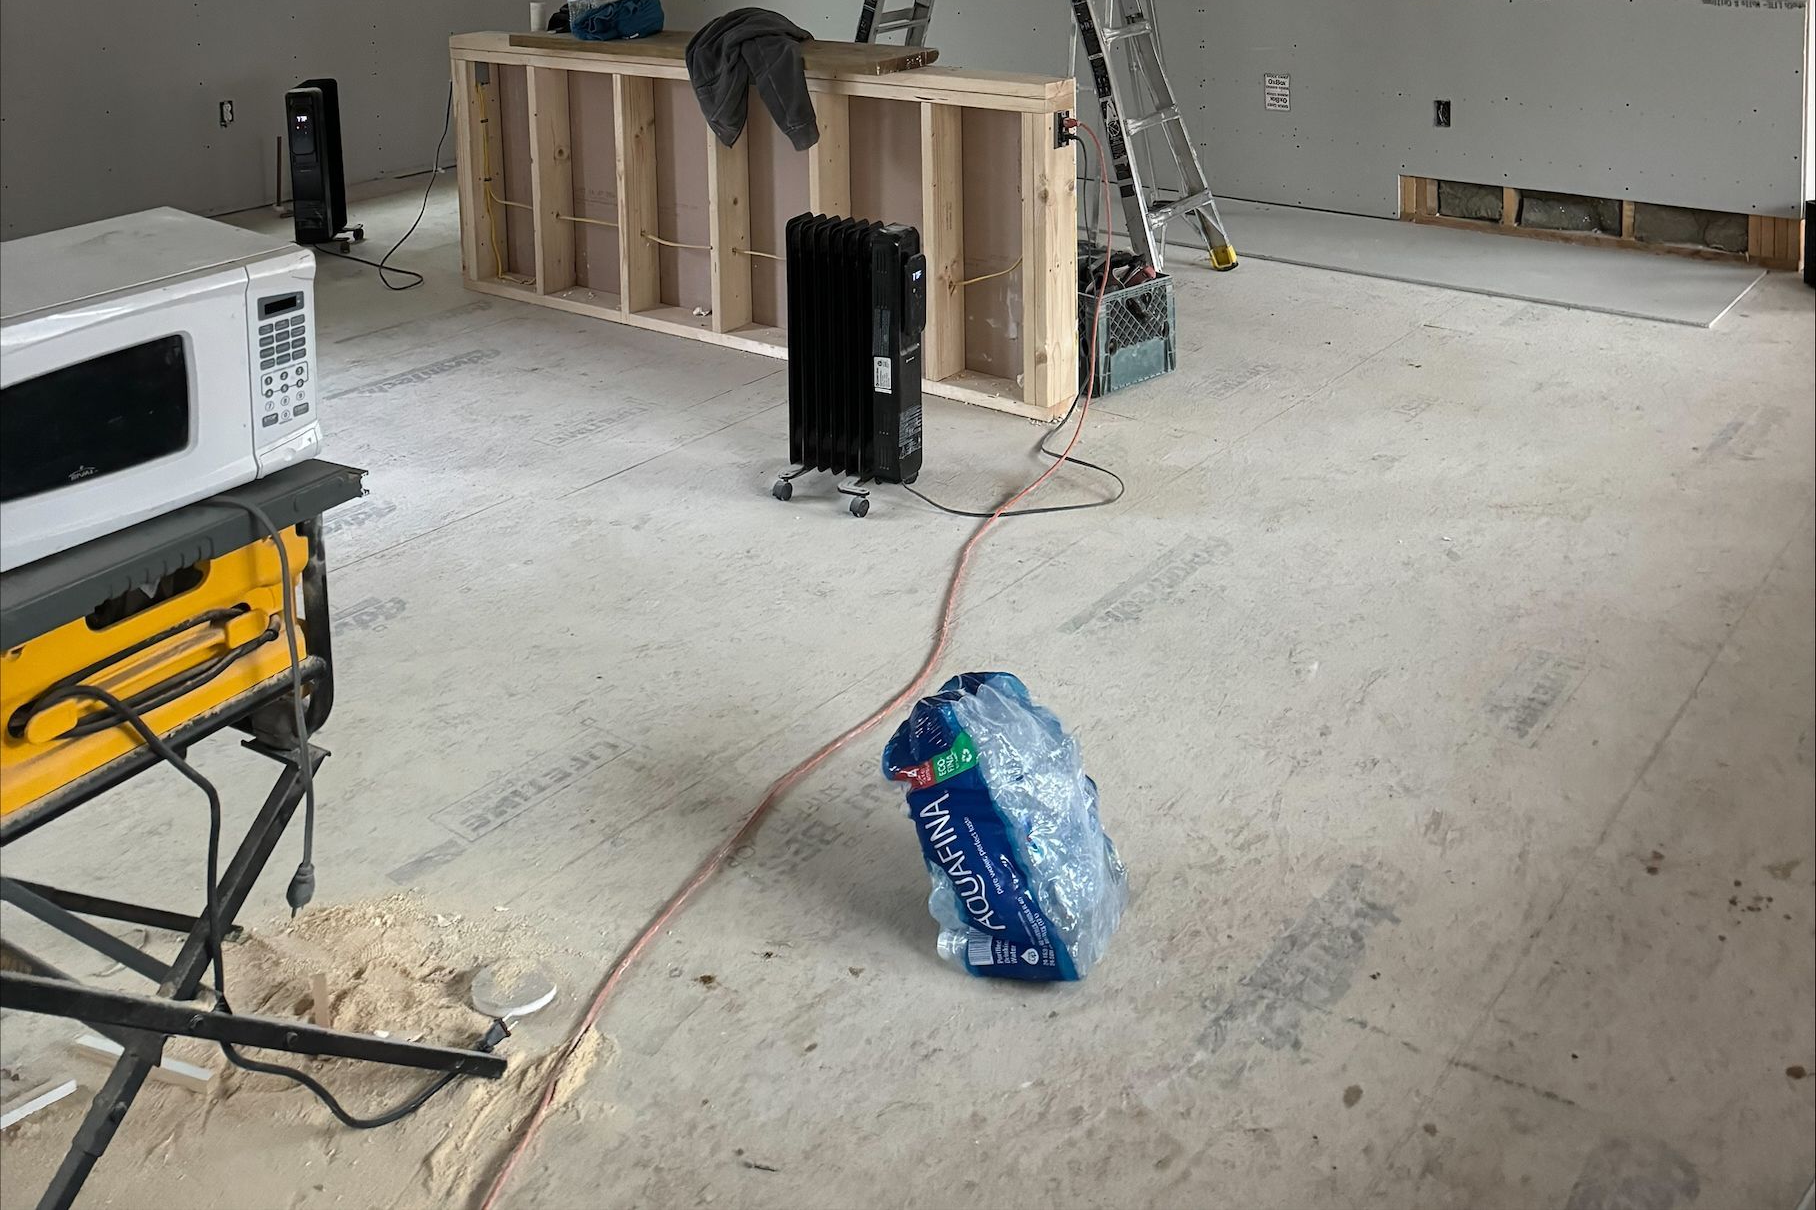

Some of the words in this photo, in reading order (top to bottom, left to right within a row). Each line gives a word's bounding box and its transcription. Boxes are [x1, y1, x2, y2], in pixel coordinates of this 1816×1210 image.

[969, 831, 987, 856] perfect
[919, 793, 1006, 932] AQUAFINA
[991, 876, 1004, 895] pure
